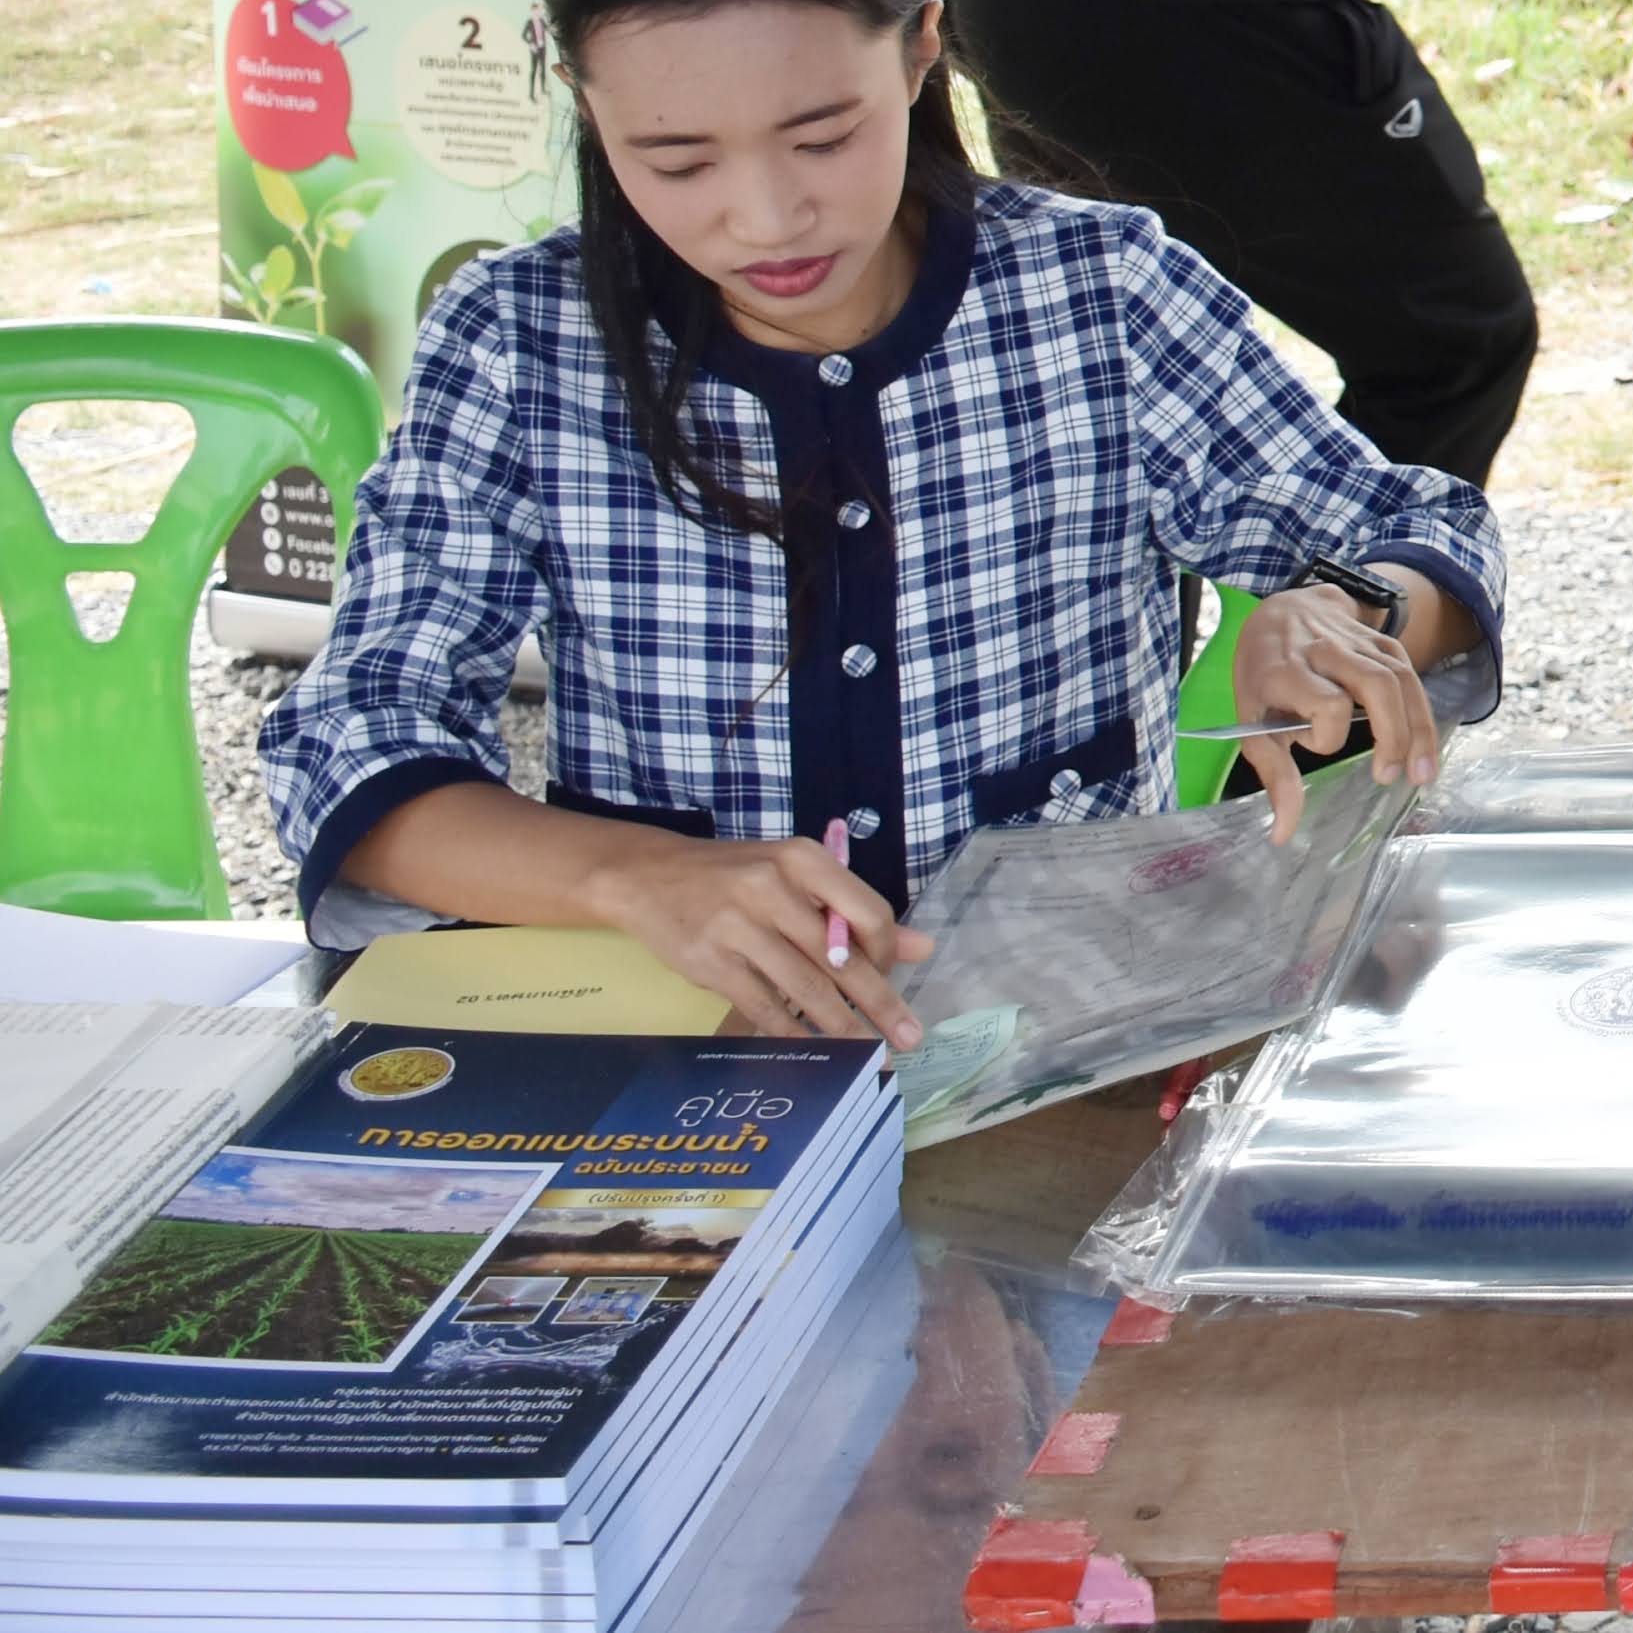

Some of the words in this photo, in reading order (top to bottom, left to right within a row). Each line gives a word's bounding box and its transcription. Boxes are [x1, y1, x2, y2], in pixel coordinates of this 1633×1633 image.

[258, 0, 279, 37] 1
[457, 17, 484, 50] 2
[674, 1088, 794, 1128] คู่มือ
[357, 1122, 770, 1154] การออกแบบระบบน้ำ
[572, 1157, 751, 1177] ฉบับประชาชน
[587, 1189, 708, 1207] (ปรับปรุงครั้งที่
[710, 1190, 726, 1205] 1)
[505, 1412, 564, 1426] (ส.ป.ก.)
